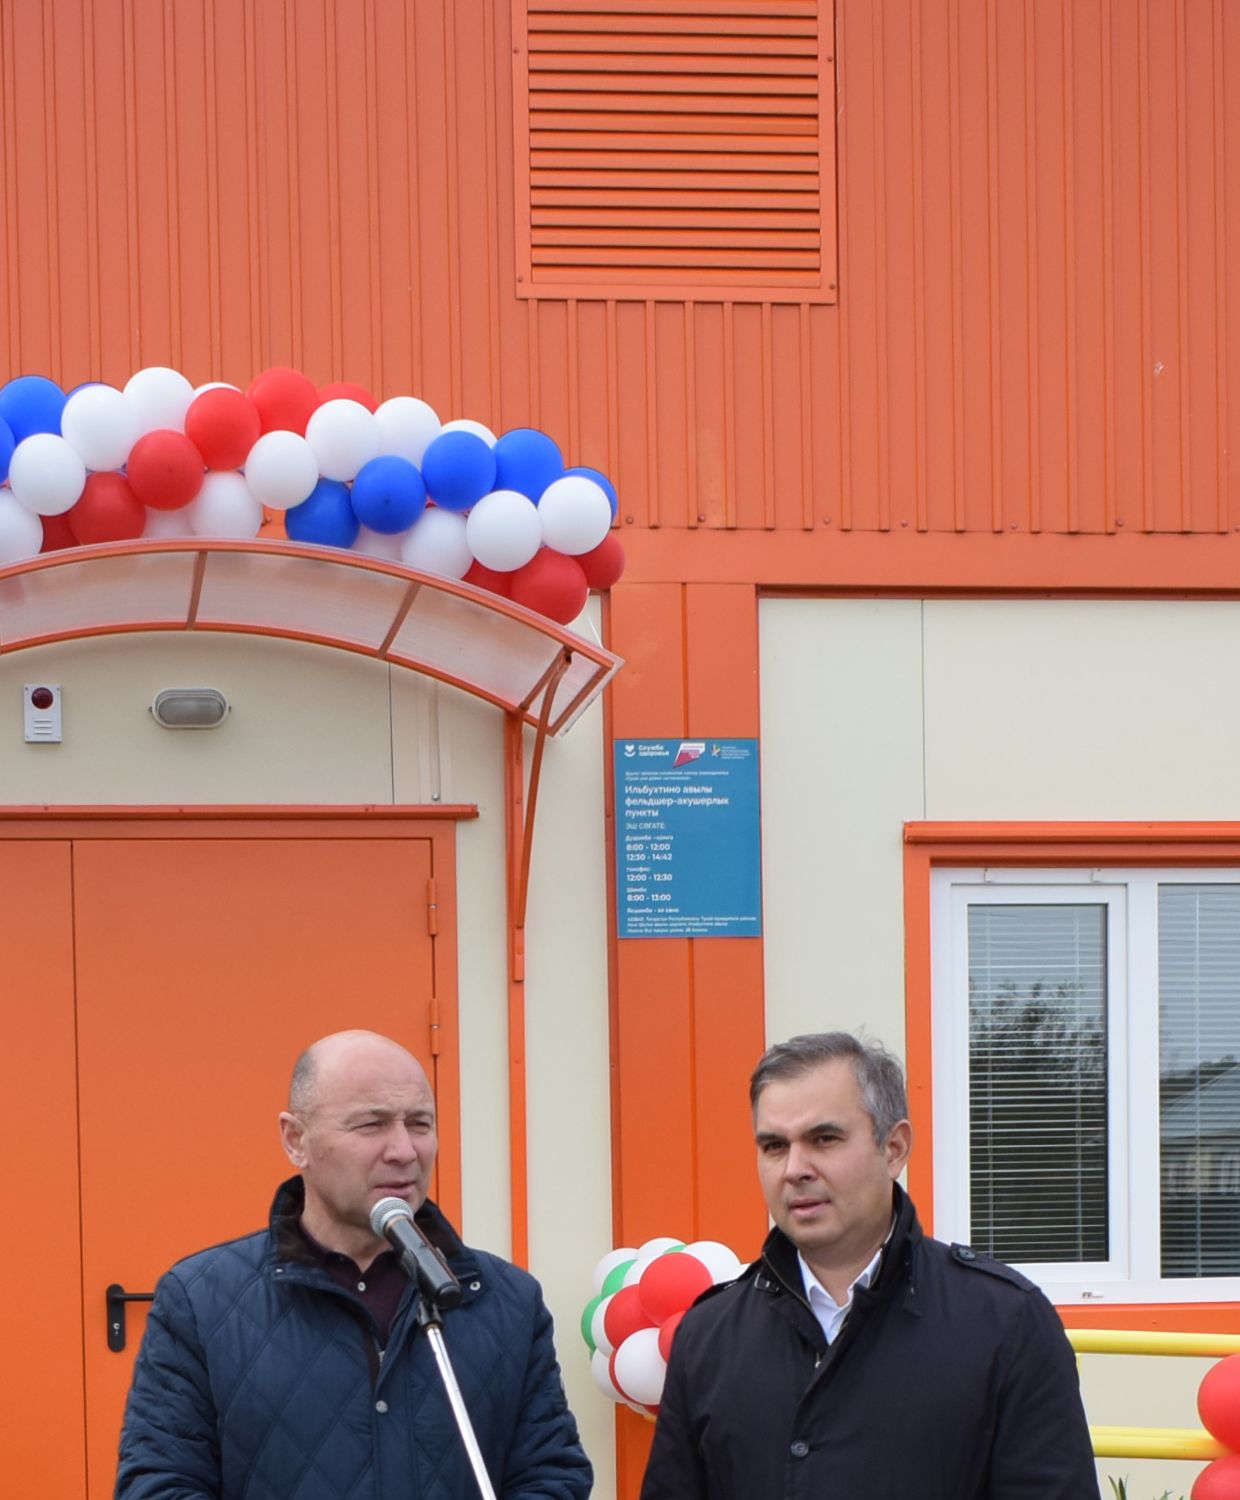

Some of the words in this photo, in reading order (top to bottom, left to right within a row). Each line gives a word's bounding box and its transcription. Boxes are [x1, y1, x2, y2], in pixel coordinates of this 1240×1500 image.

[625, 785, 681, 796] Ильбухтино
[682, 786, 713, 794] авылы
[625, 797, 729, 807] фельдшер-акушерлык
[625, 809, 659, 819] пункты
[626, 843, 644, 851] 8:00
[650, 843, 671, 851] 12:00
[652, 853, 673, 861] 14:42
[626, 874, 647, 882] 12:00
[653, 873, 673, 881] 12:30
[627, 894, 645, 902] 8:00
[651, 894, 671, 902] 13:00
